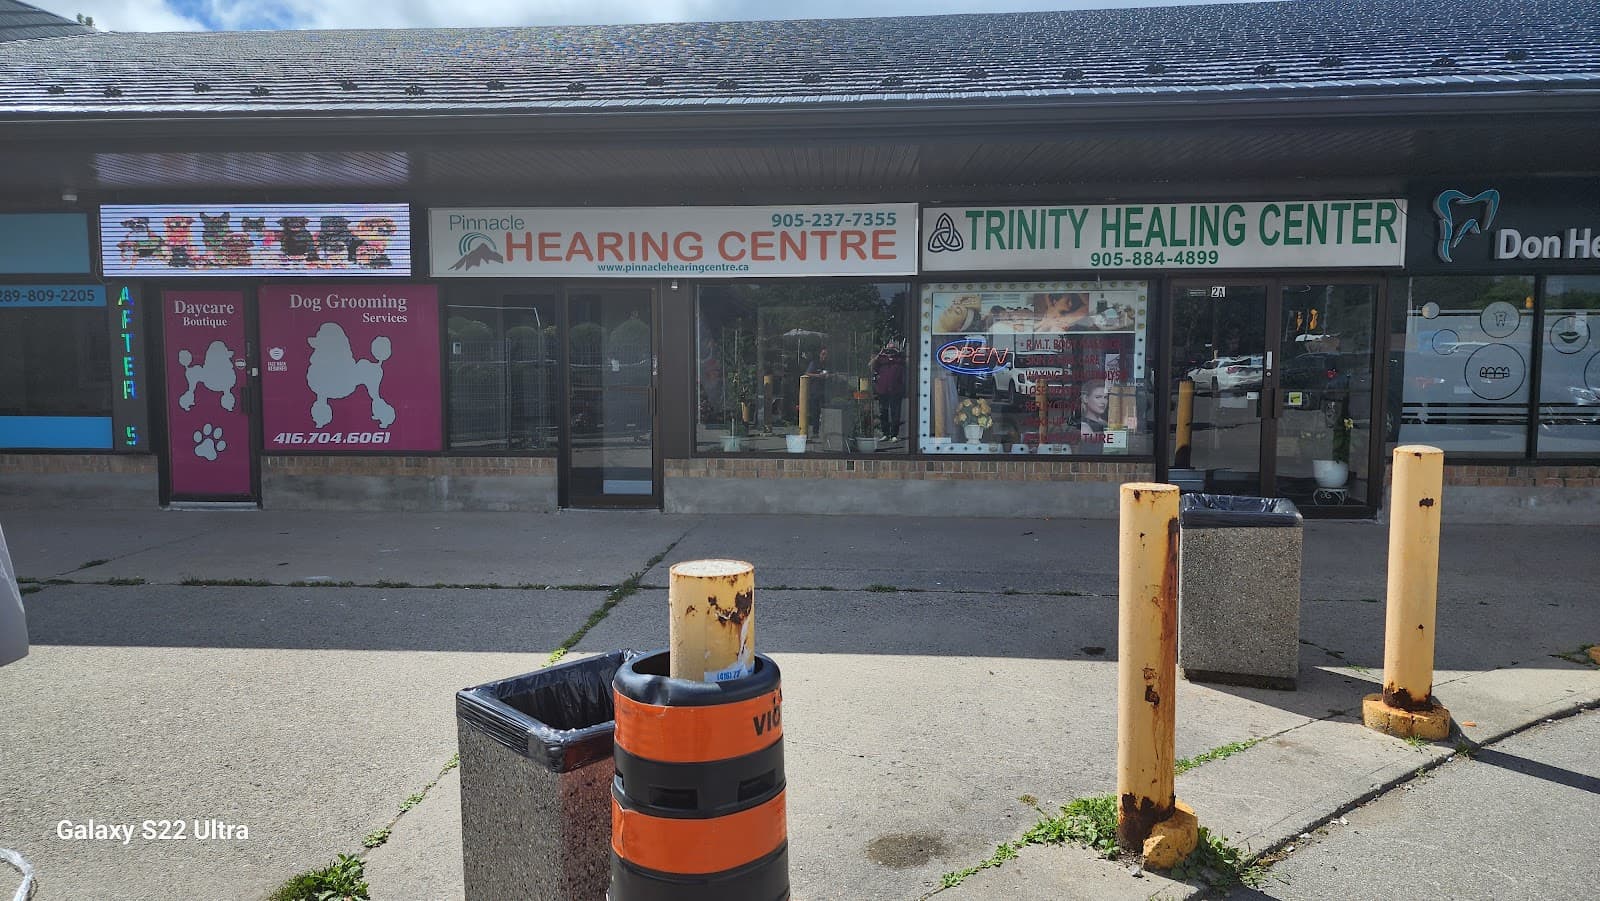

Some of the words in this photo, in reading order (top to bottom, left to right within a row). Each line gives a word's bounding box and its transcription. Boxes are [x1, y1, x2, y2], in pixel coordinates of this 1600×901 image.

[449, 214, 525, 231] Pinnacle
[771, 212, 897, 228] 905-237-7355
[965, 207, 1089, 250] TRINITY
[1101, 204, 1246, 248] HEALING
[1259, 202, 1398, 246] CENTER
[506, 231, 704, 262] HEARING
[717, 229, 897, 262] CENTRE
[1497, 228, 1561, 259] Don
[1090, 250, 1219, 267] 905-884-4899
[597, 262, 749, 274] www.pinnaclehearingcentre.ca
[174, 300, 235, 316] Daycare
[289, 294, 322, 311] Dog
[326, 294, 408, 312] Grooming
[182, 317, 228, 328] Boutique
[362, 312, 408, 323] Services
[941, 346, 1008, 364] OPEN
[273, 432, 391, 444] 416.704.6061
